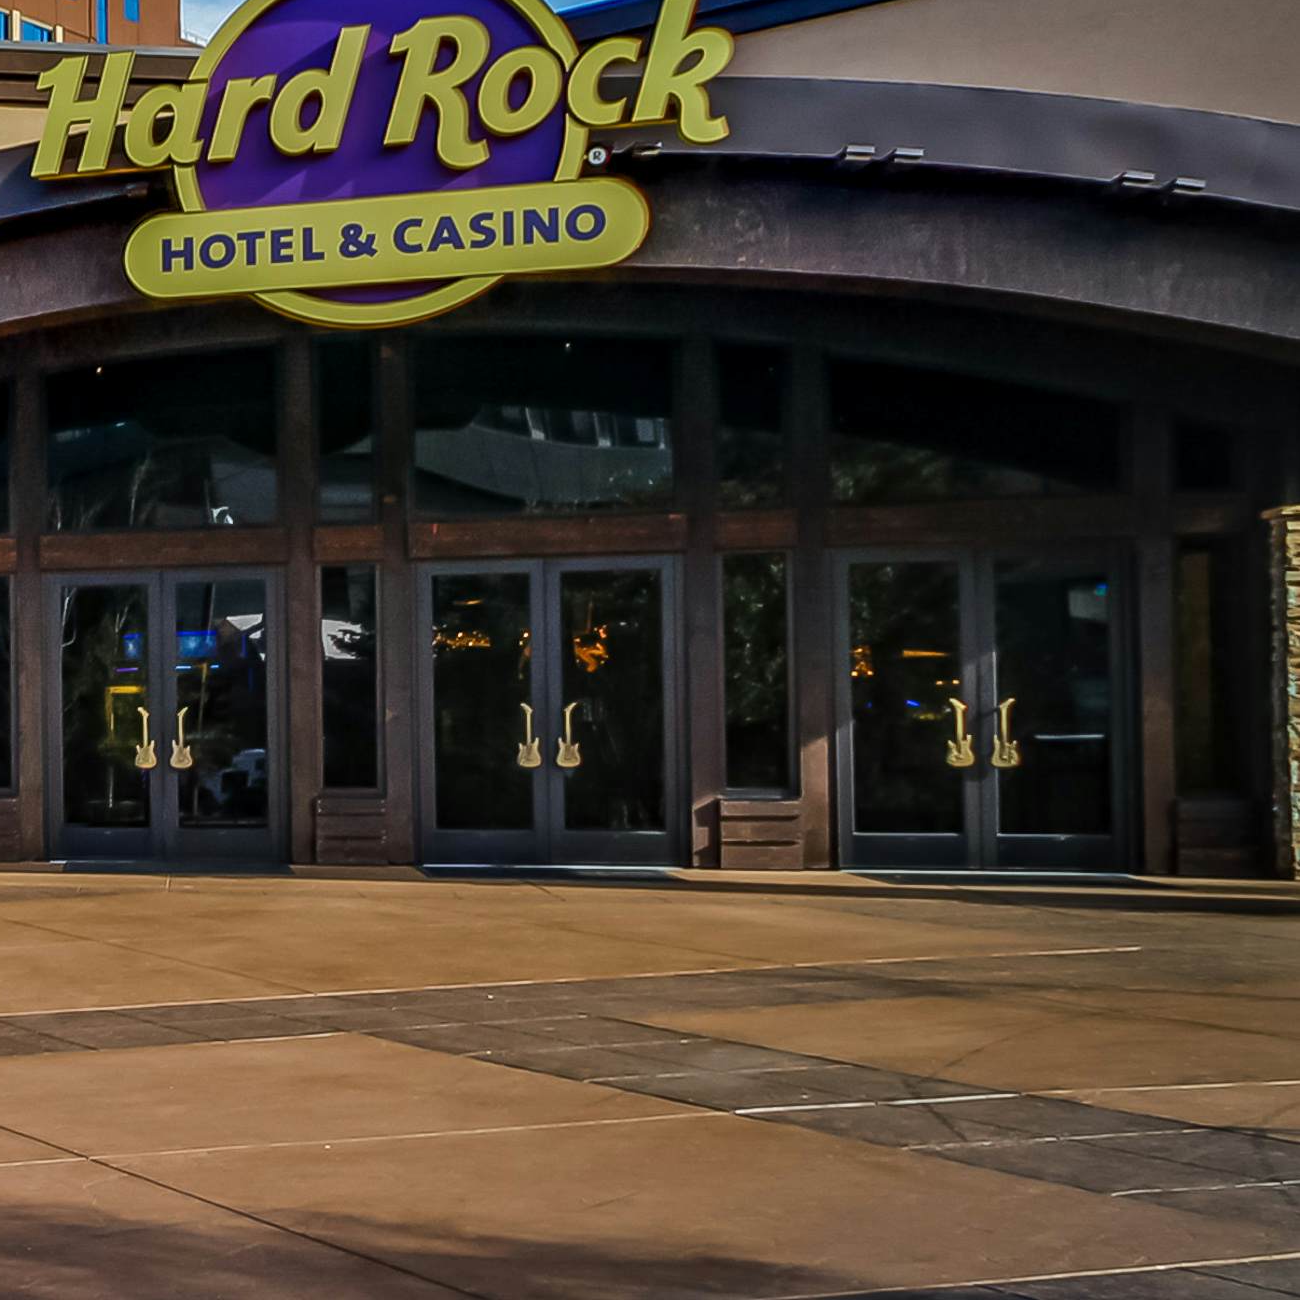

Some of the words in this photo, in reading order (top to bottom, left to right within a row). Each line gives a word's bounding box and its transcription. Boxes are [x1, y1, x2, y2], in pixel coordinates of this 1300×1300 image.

[30, 24, 371, 179] Hard
[161, 227, 325, 272] HOTEL
[339, 222, 378, 258] &
[393, 204, 607, 253] CASINO
